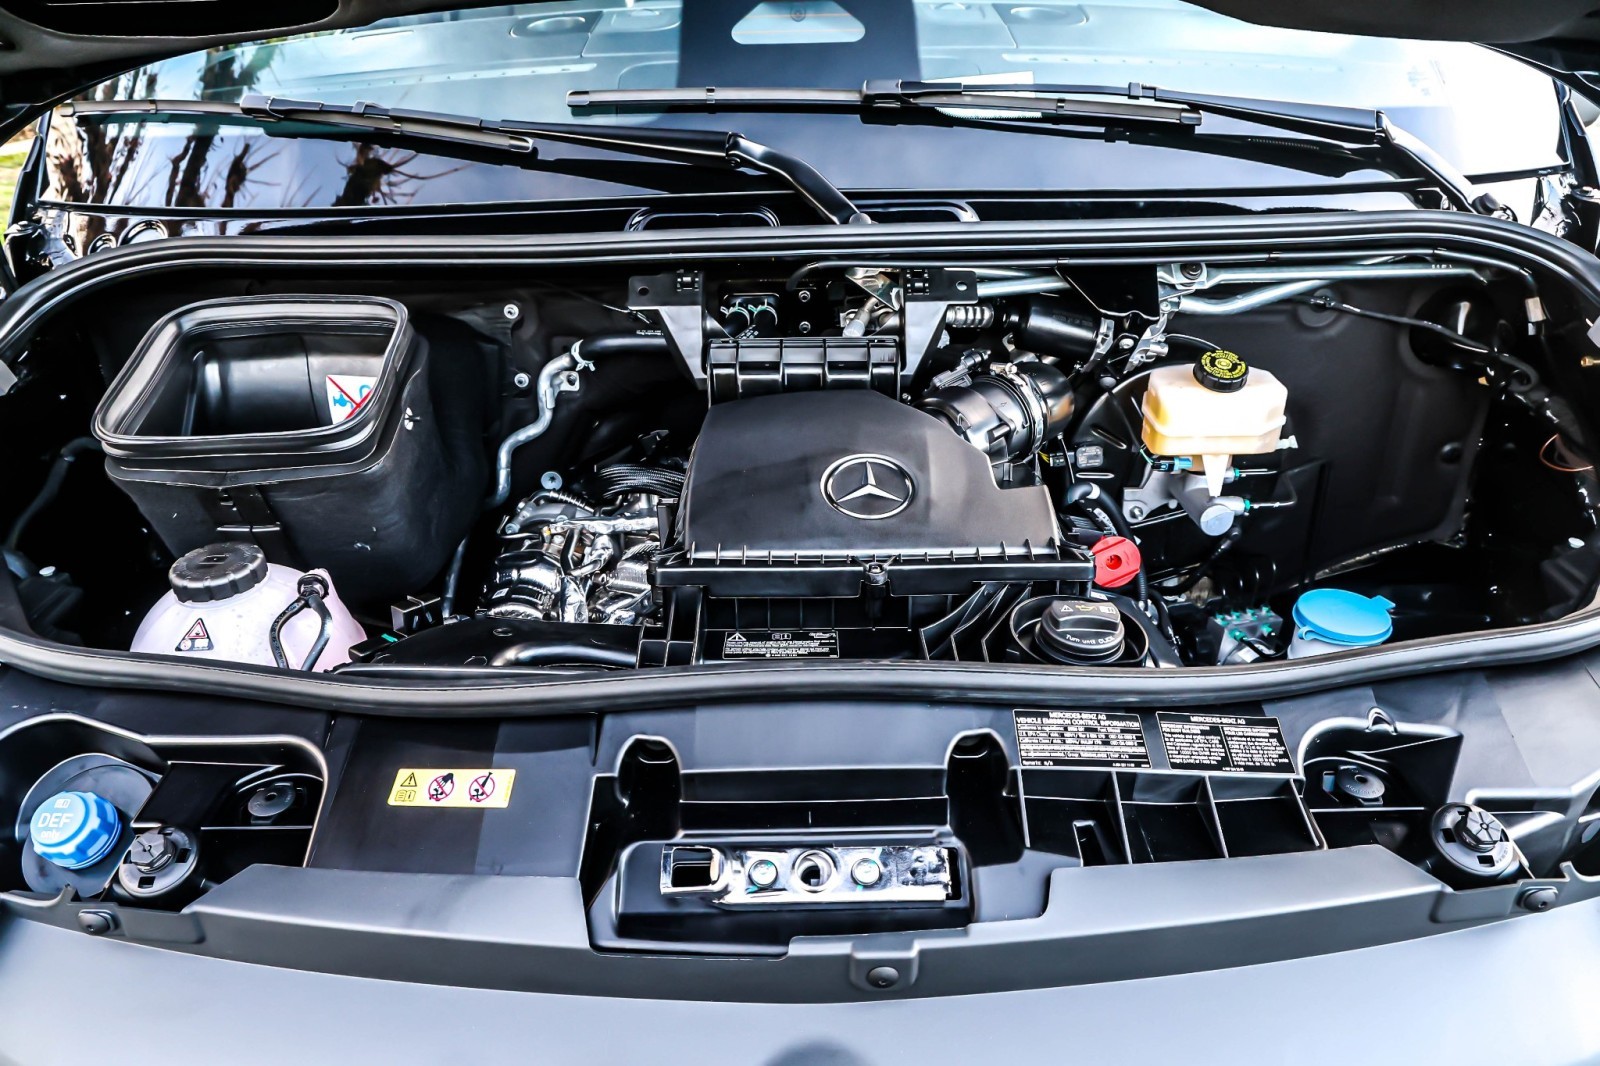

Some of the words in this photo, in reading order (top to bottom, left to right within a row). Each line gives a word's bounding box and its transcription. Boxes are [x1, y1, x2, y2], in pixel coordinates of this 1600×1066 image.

[1065, 634, 1080, 643] Turn
[1190, 716, 1236, 724] MERCEDES-BENZ
[38, 812, 74, 828] DEF
